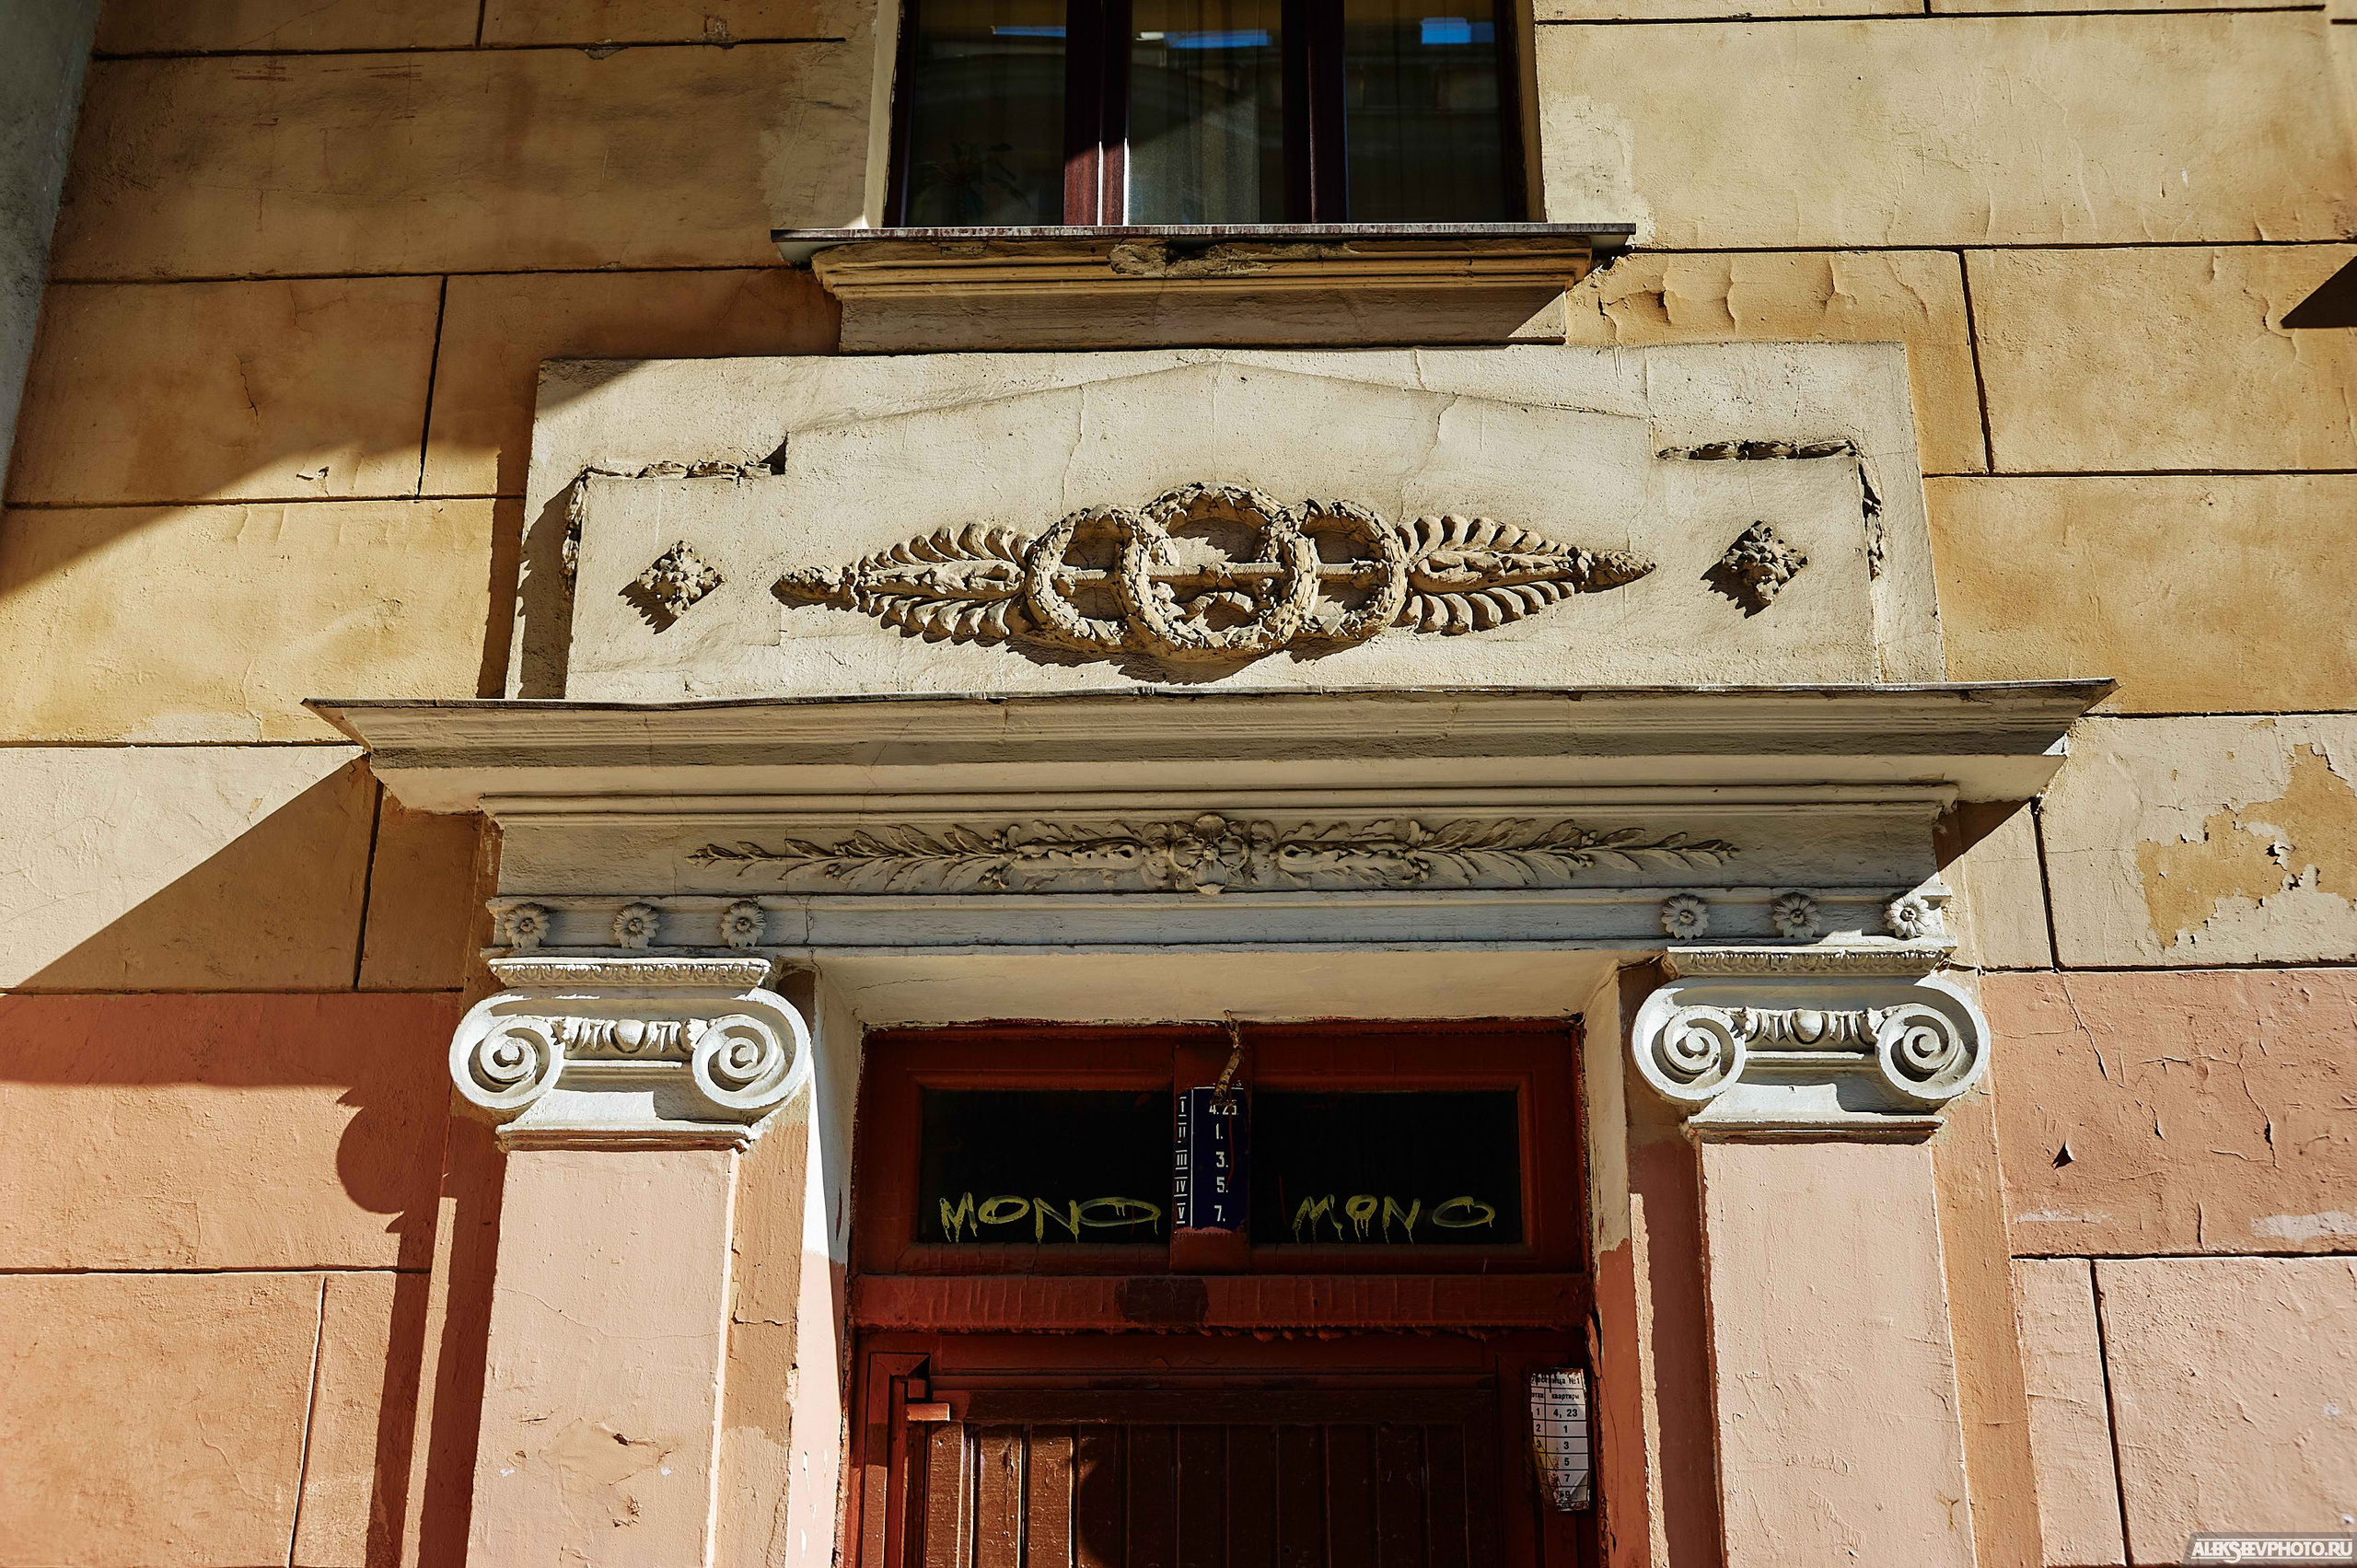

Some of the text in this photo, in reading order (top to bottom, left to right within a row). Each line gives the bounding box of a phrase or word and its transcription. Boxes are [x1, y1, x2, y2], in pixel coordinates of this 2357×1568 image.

[1178, 1122, 1224, 1143] II 1.
[1175, 1150, 1229, 1170] III 3.
[1174, 1177, 1229, 1197] IV 5.
[939, 1191, 1162, 1243] MONO
[1176, 1202, 1226, 1224] V 7.
[1552, 1408, 1562, 1419] 4,
[1566, 1409, 1578, 1417] 23
[1536, 1423, 1568, 1434] 2 1
[1536, 1440, 1570, 1450] 3 3
[1564, 1458, 1570, 1466] 5
[1564, 1474, 1571, 1482] 7
